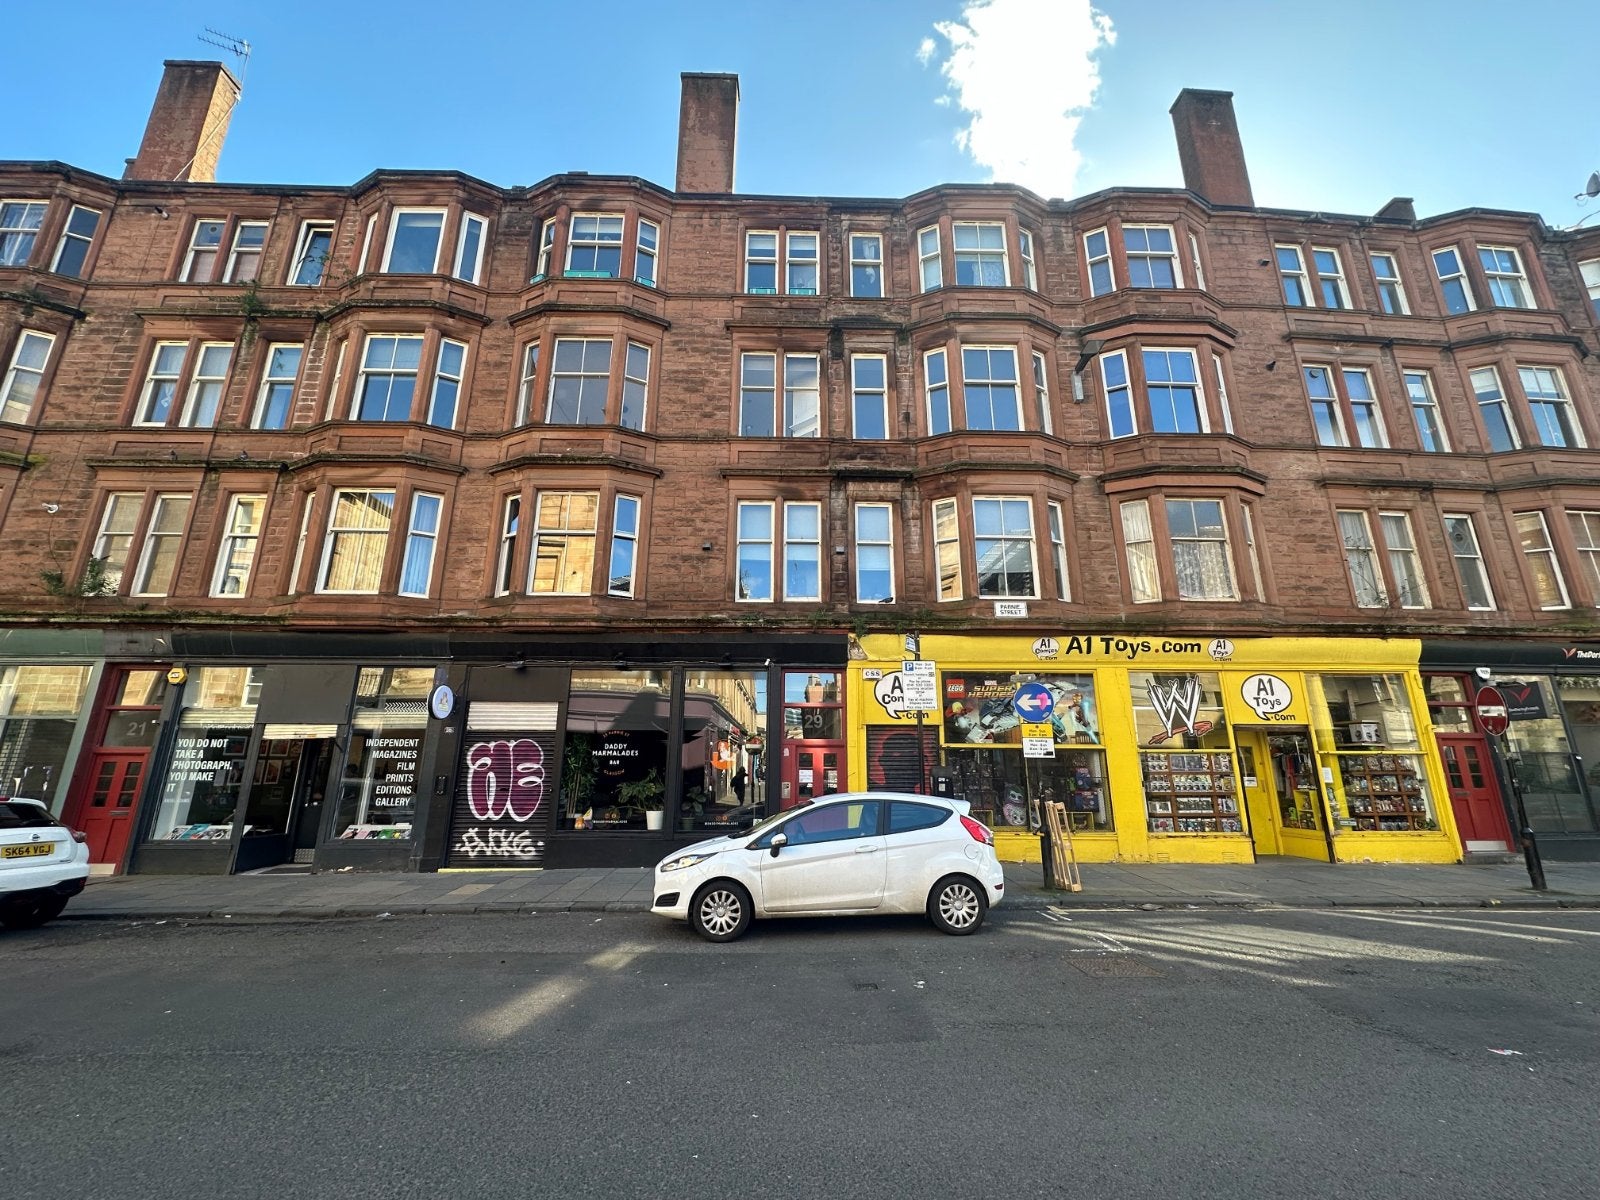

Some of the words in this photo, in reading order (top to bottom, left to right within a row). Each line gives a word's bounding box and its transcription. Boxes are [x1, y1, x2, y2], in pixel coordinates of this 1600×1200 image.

[1040, 638, 1051, 648] A1
[1066, 636, 1092, 655] A1
[1215, 640, 1226, 650] A1
[947, 684, 964, 692] LEGO
[1257, 678, 1275, 696] A1
[1253, 697, 1282, 710] Toys
[804, 714, 823, 729] 29
[126, 721, 147, 736] 21
[178, 739, 195, 748] YOU
[196, 739, 208, 748] DO
[210, 739, 229, 748] NOT
[366, 739, 420, 747] INDEPENDENT
[175, 749, 197, 759] TAKE
[197, 749, 204, 759] A
[372, 750, 418, 759] MAGAZINES
[172, 761, 233, 770] PHOTOGRAPH.
[397, 762, 416, 771] FILM
[170, 772, 188, 781] YOU
[189, 772, 214, 781] MAKE
[385, 773, 414, 782] PRINTS
[166, 783, 176, 792] IT
[375, 785, 412, 794] EDITIONS
[375, 797, 411, 806] GALLERY
[5, 846, 30, 857] SK64
